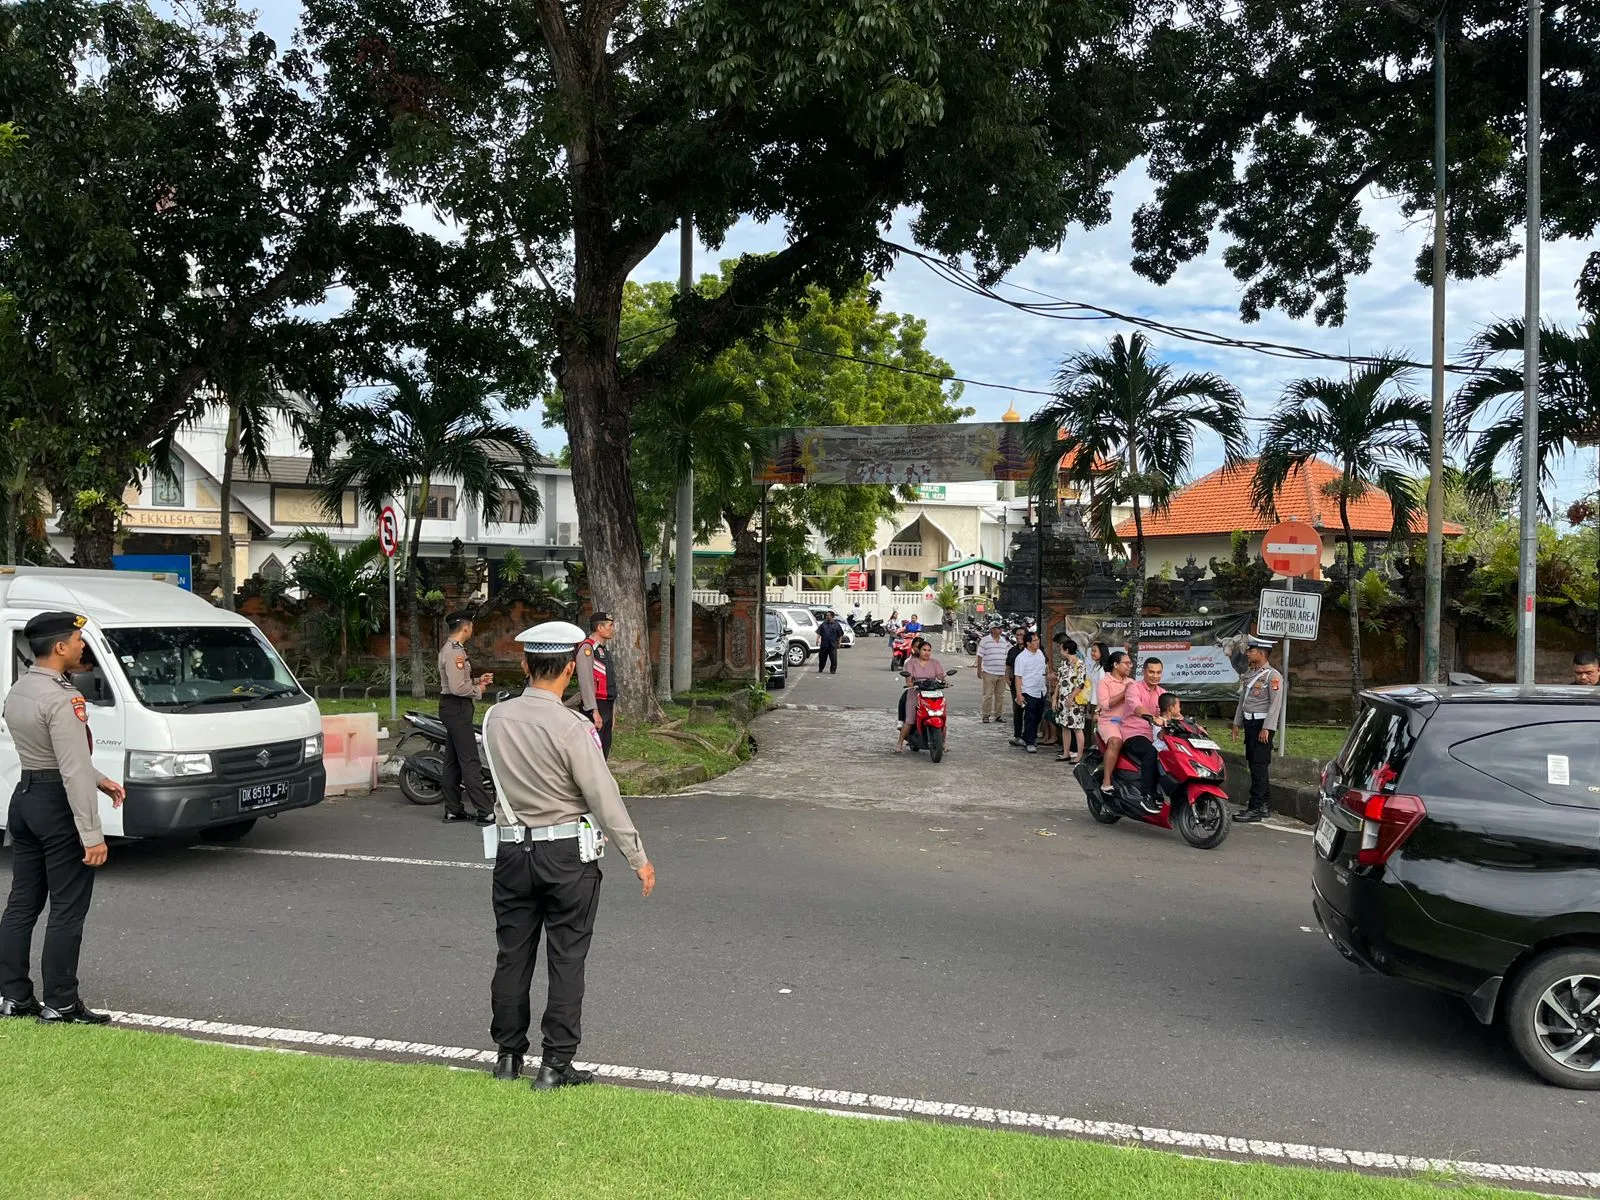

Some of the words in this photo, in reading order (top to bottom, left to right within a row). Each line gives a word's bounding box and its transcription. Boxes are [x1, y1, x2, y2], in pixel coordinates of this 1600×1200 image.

[140, 513, 196, 525] EKKLESIA
[1276, 595, 1306, 609] KECUALI
[1262, 607, 1297, 621] PENGGUNA
[1297, 611, 1316, 622] AREA
[1156, 620, 1175, 628] 1446
[1262, 619, 1288, 633] TEMPAT
[1288, 622, 1314, 635] IBADAH
[1123, 629, 1149, 637] Mjid
[242, 789, 252, 801] DK
[252, 785, 271, 799] 8513
